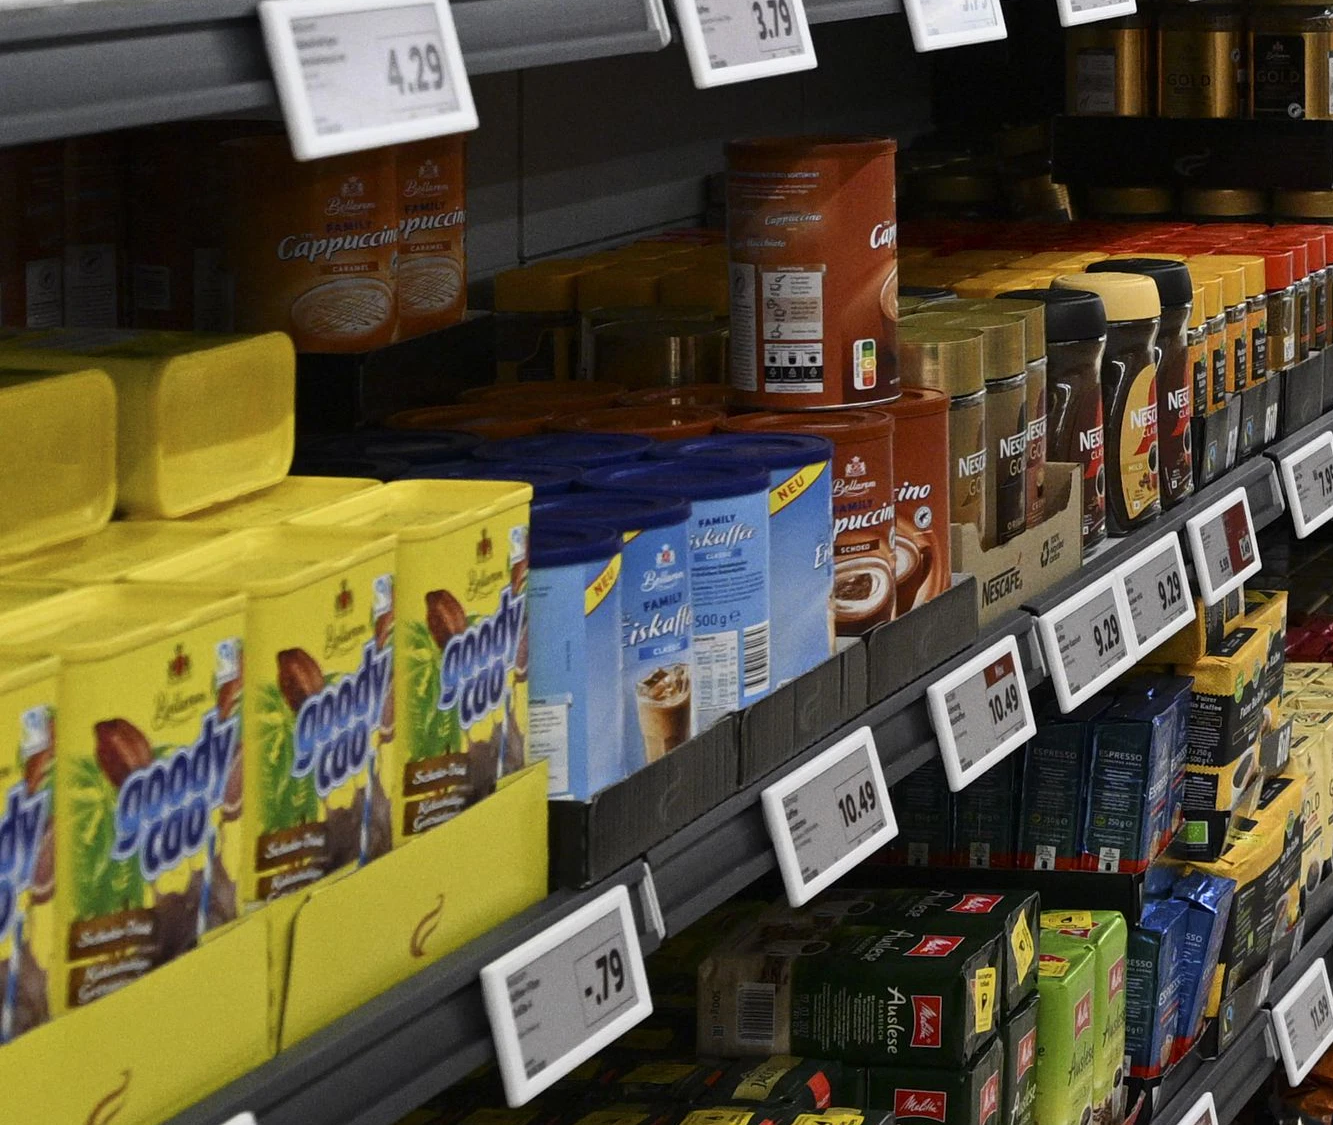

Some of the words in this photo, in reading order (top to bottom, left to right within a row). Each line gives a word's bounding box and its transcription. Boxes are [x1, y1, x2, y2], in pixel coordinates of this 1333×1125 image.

[388, 43, 445, 96] 4.29
[277, 225, 399, 262] Cappuccin
[1130, 401, 1158, 429] NESC
[1000, 429, 1026, 460] NESC
[959, 449, 987, 479] NESC
[778, 476, 805, 502] NEU
[833, 477, 876, 499] Bellarom
[689, 523, 757, 550] iskaffee
[699, 514, 736, 527] FAMILY
[839, 542, 871, 554] SCHOKO
[594, 568, 615, 597] NEU
[1157, 570, 1182, 612] 9.29
[643, 592, 683, 612] FAMILY
[695, 613, 718, 629] 500
[1095, 613, 1120, 658] 9.29
[438, 585, 526, 712] goody
[291, 638, 394, 778] goody
[988, 682, 1020, 726] 10.49
[315, 719, 370, 799] cao
[1099, 749, 1143, 762] ESPRESSO
[111, 706, 240, 862] goody
[837, 779, 876, 829] 10.49
[139, 797, 210, 881] cao
[887, 985, 907, 1055] Auslese
[1310, 999, 1330, 1033] 11.99
[903, 1091, 939, 1114] Melitta
